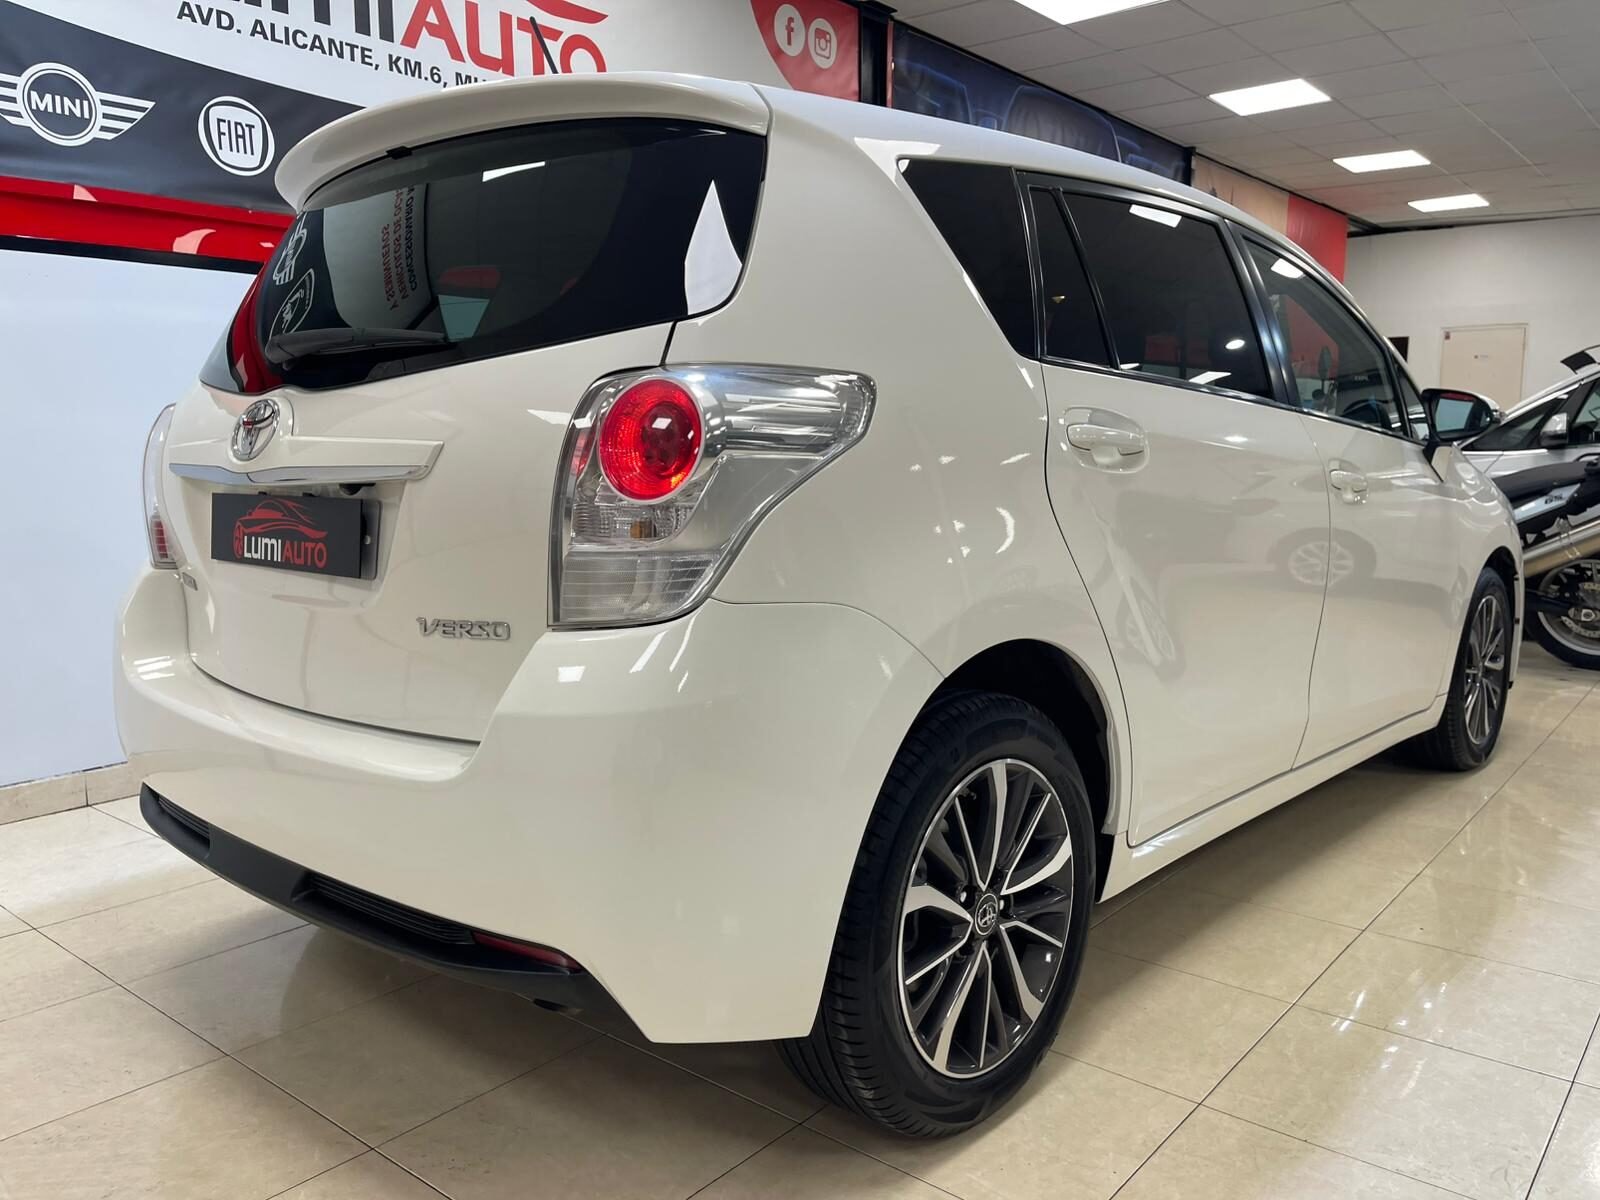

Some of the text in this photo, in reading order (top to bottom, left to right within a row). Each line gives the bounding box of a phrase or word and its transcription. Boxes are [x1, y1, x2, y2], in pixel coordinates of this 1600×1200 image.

[176, 1, 242, 34] AVD.
[249, 19, 380, 71] ALICANTE,
[388, 53, 448, 88] KM.6,
[30, 90, 90, 119] MINI
[216, 117, 255, 155] FIAT
[416, 616, 511, 640] VERSO
